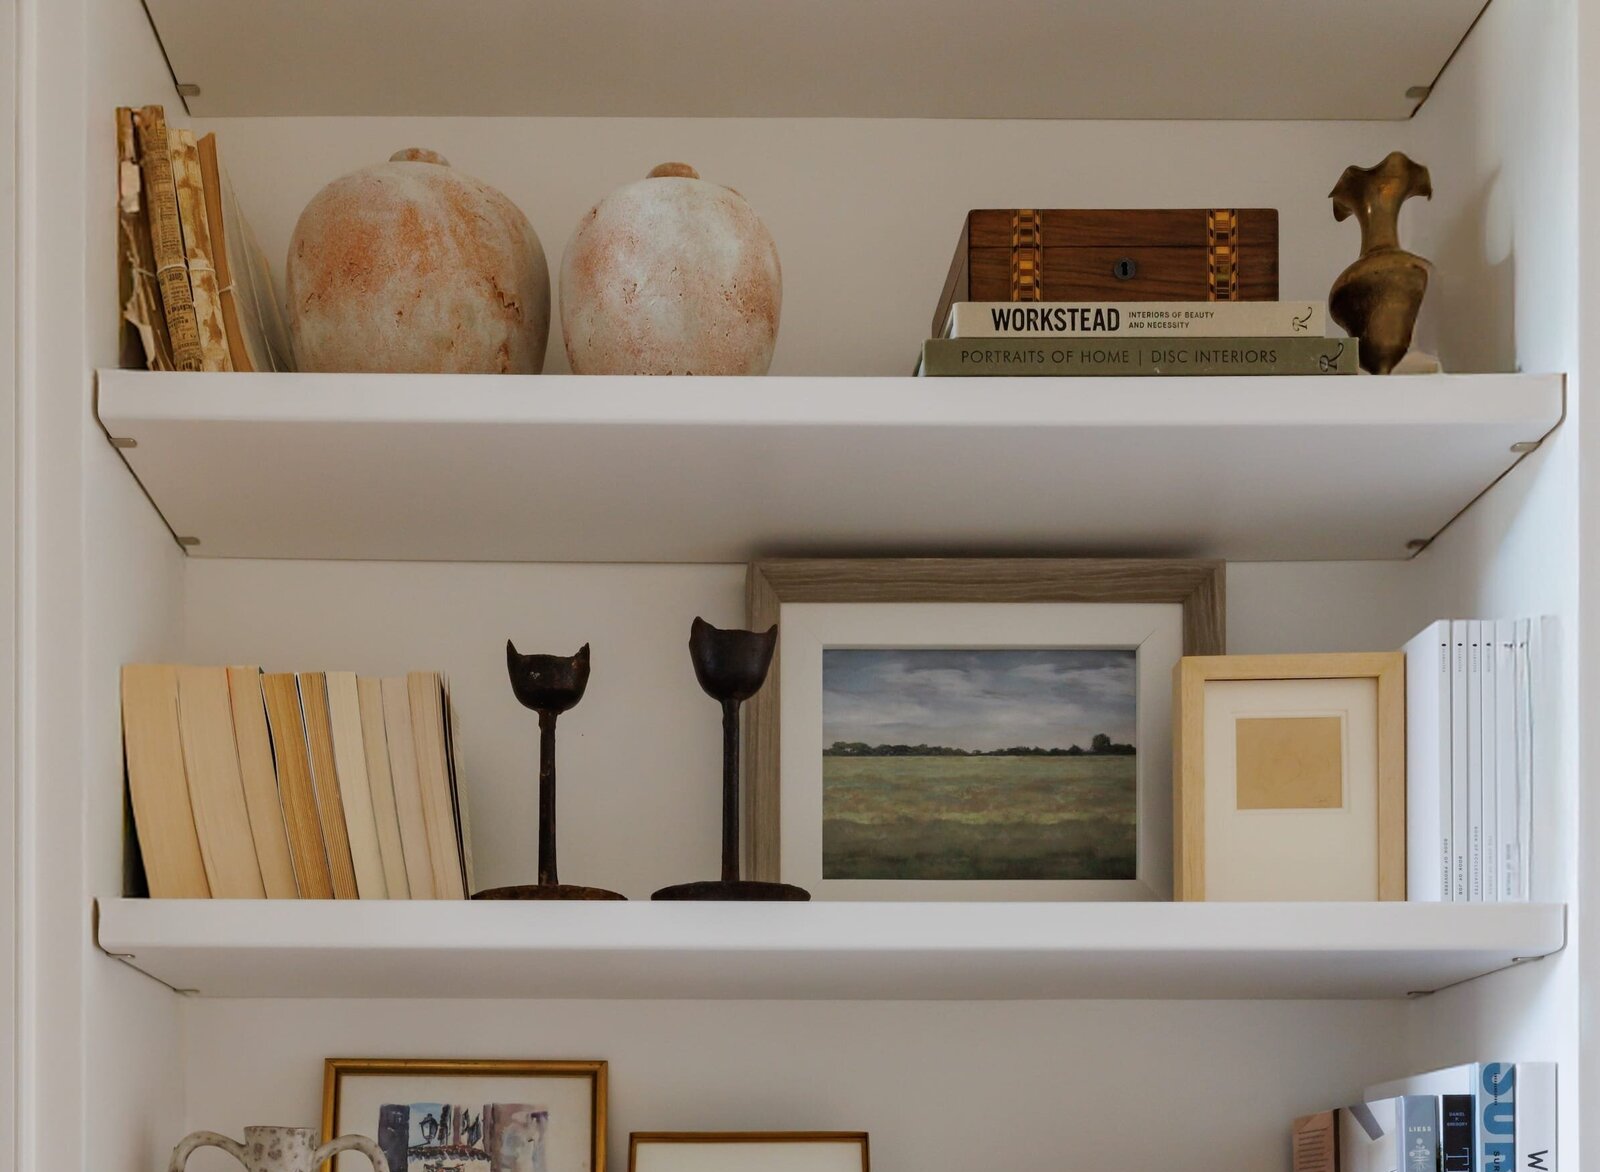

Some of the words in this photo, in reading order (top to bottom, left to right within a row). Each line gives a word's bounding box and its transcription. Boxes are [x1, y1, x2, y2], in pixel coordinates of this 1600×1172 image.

[991, 308, 1120, 331] WORKSTEAD
[1128, 311, 1170, 319] INTERIORS
[1172, 311, 1183, 319] OF
[1184, 311, 1215, 319] BEAUTY
[1128, 321, 1145, 329] AND
[1147, 321, 1190, 329] NECESSITY
[961, 350, 1045, 363] PORTRAITS
[1051, 350, 1073, 363] OF
[1081, 350, 1129, 363] HOME
[1151, 350, 1189, 363] DISC
[1195, 350, 1278, 363] INTERIORS
